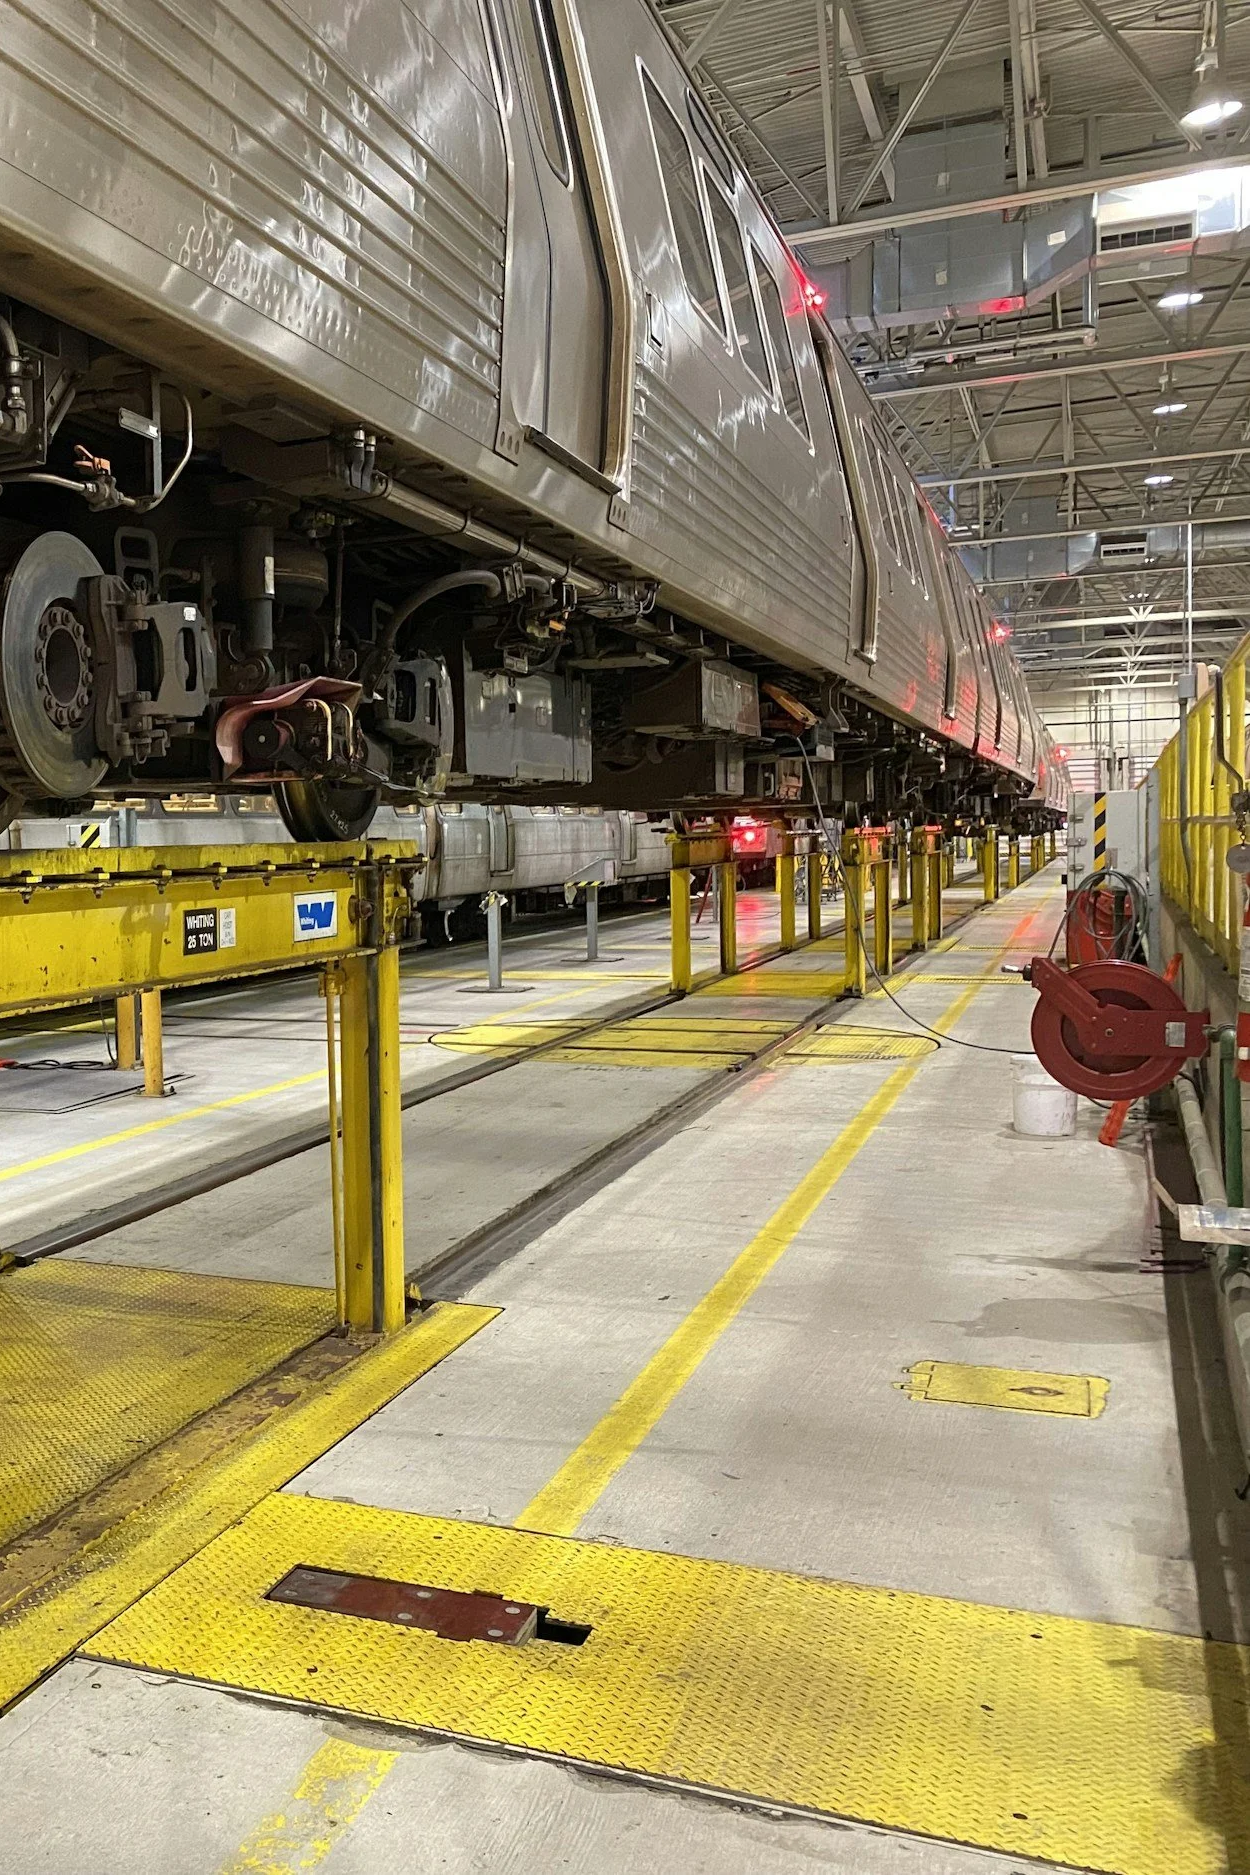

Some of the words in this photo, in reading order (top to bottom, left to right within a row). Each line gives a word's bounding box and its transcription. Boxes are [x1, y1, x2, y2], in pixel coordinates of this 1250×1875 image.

[186, 914, 215, 930] WHITING
[187, 936, 197, 949] 25
[199, 933, 214, 948] TON
